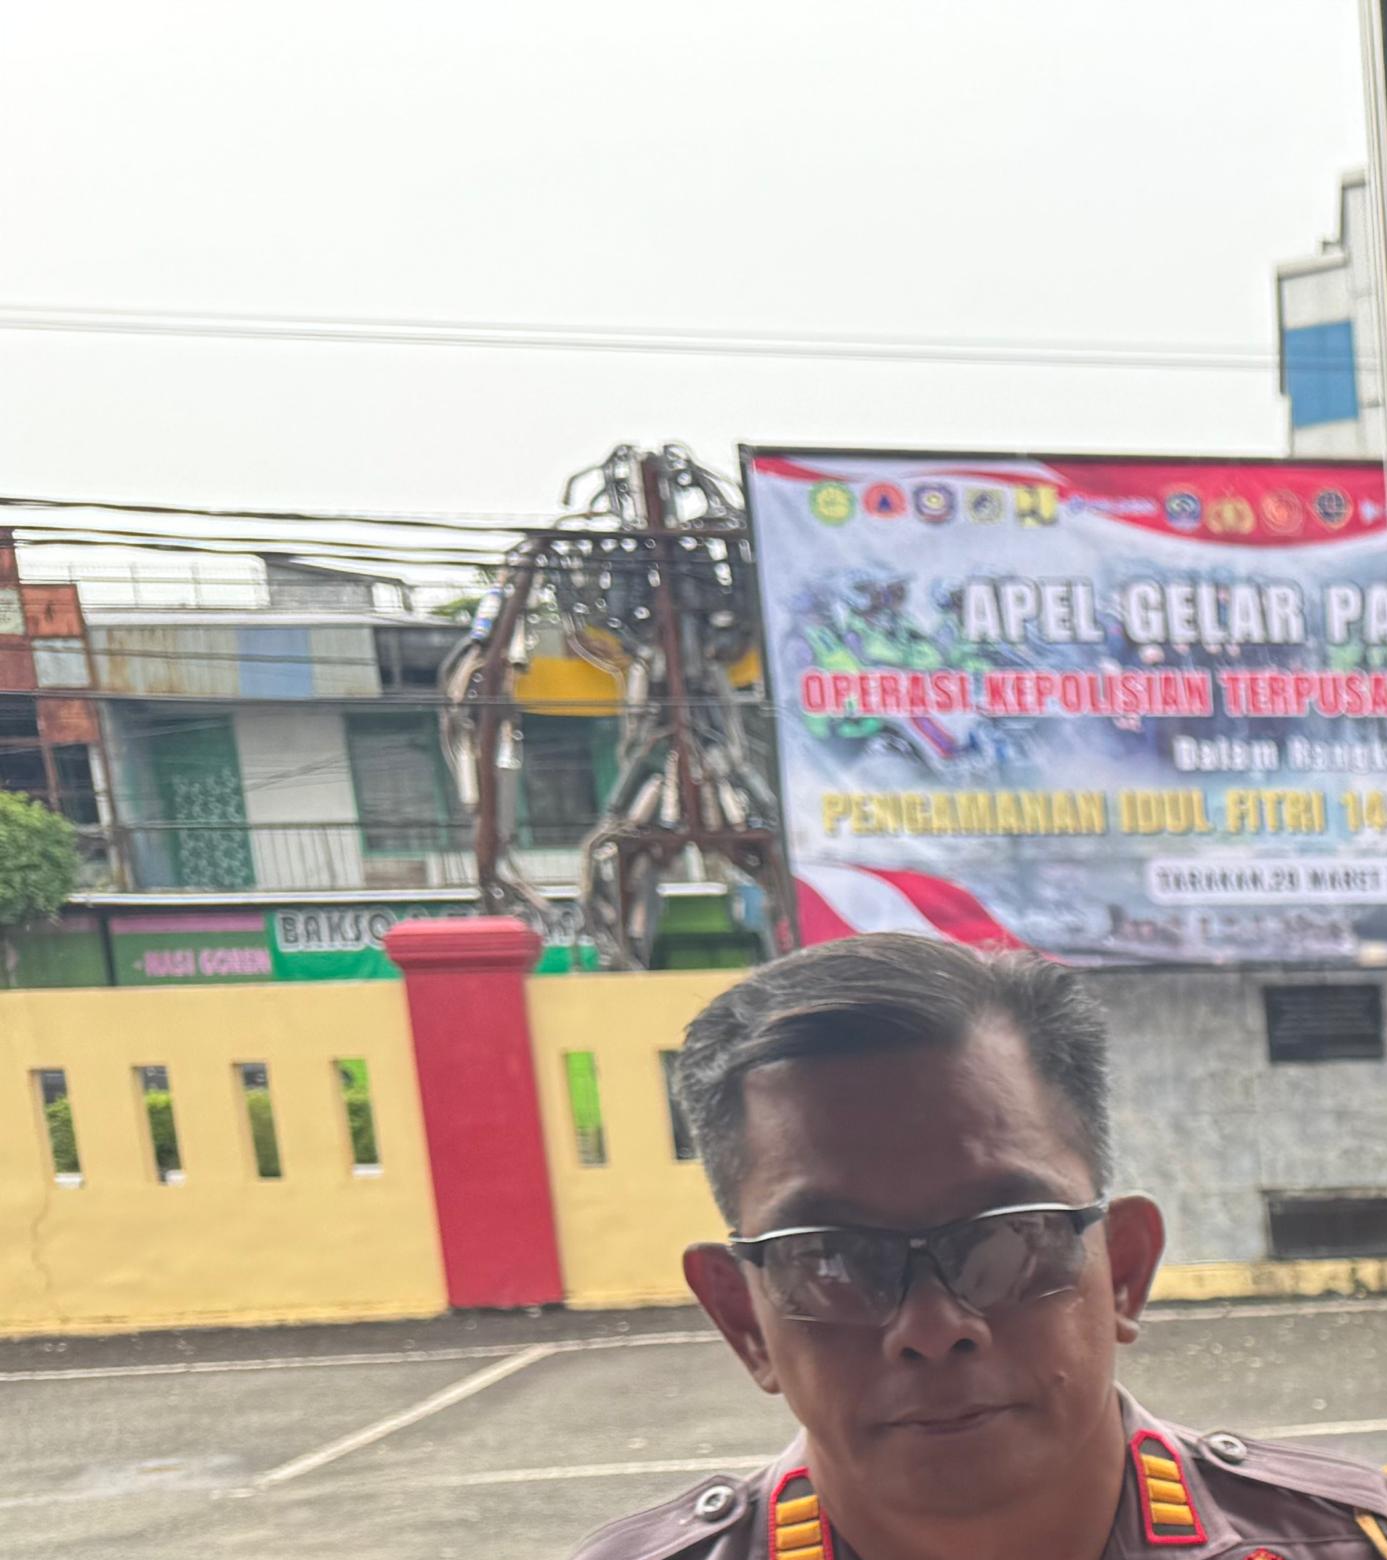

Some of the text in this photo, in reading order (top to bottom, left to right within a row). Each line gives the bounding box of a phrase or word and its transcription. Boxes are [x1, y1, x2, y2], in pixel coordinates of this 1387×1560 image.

[965, 577, 1103, 643] APEL
[1124, 578, 1304, 645] GELAR
[802, 671, 973, 716] OPERASI
[985, 671, 1211, 716] KEPOLISIAN
[1173, 735, 1278, 771] Dalam
[821, 791, 1104, 835] PENGAMANAN
[1120, 790, 1211, 834] IDUL
[1226, 789, 1325, 833] FITRI
[282, 911, 396, 943] BAKSO
